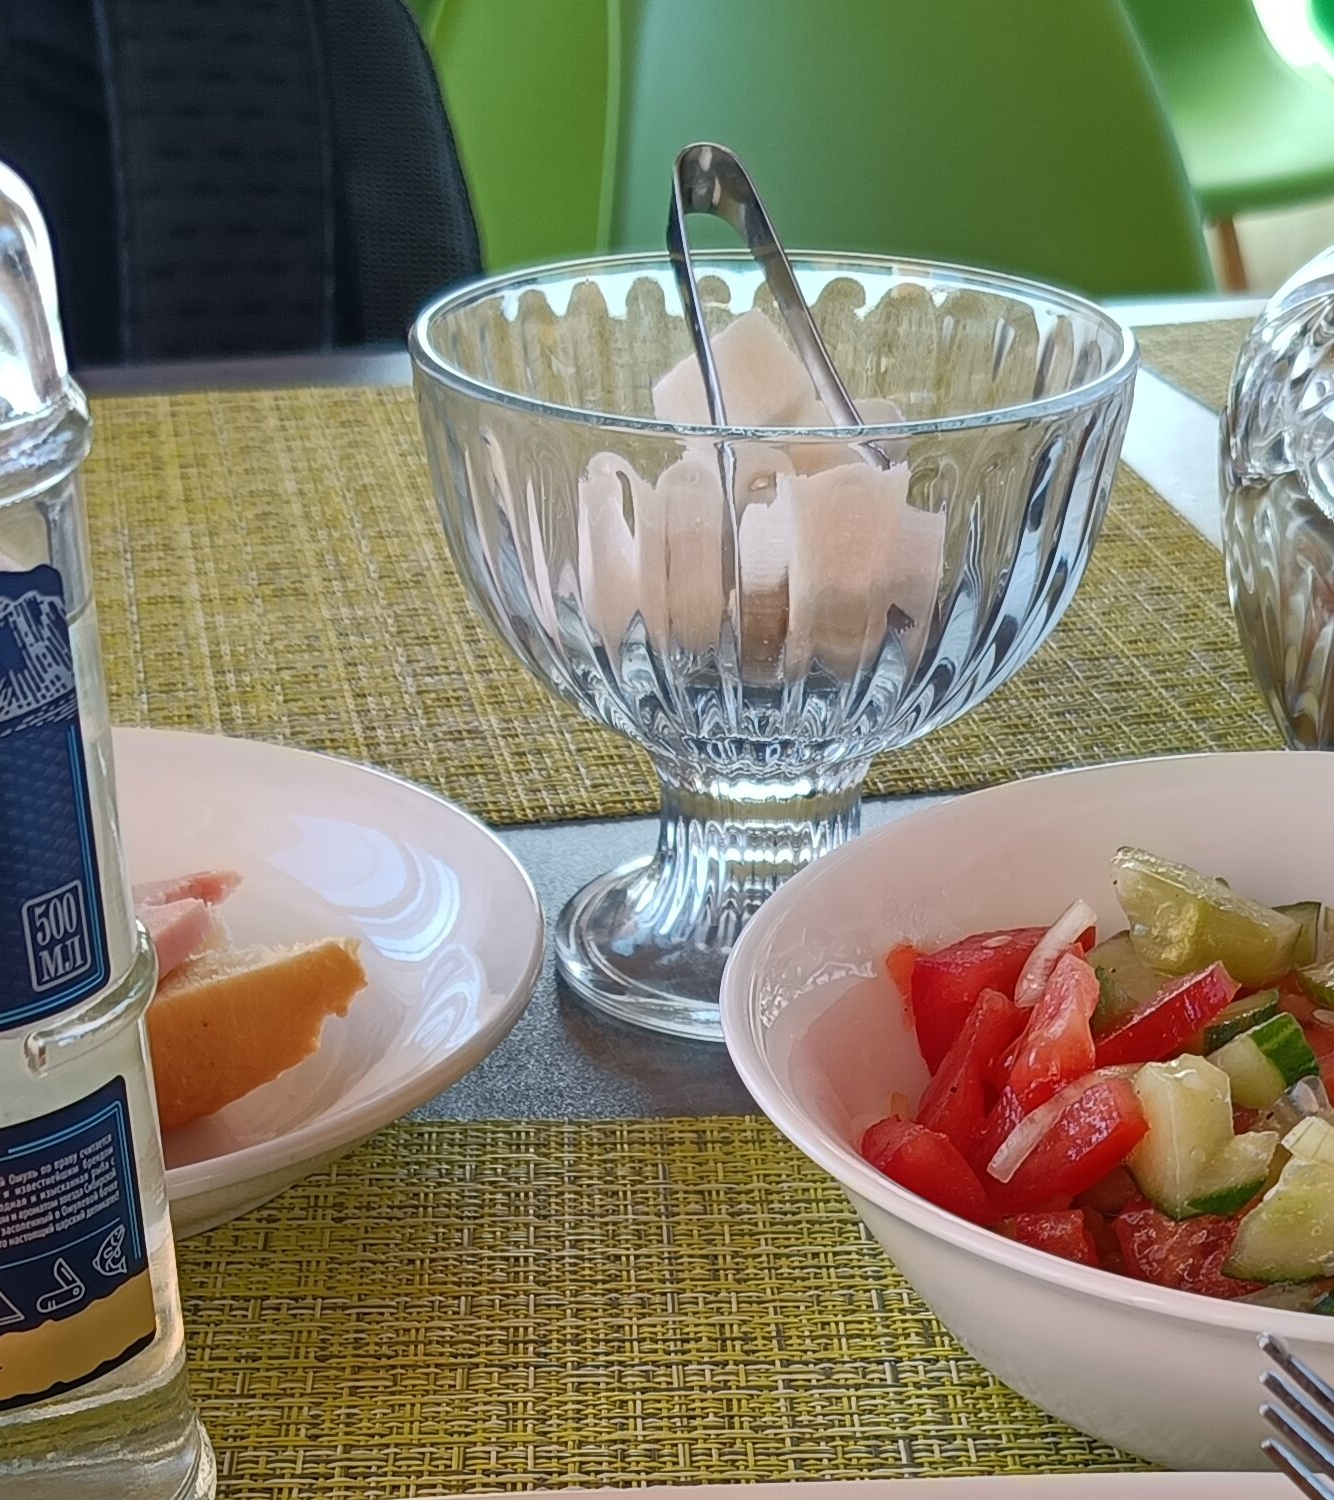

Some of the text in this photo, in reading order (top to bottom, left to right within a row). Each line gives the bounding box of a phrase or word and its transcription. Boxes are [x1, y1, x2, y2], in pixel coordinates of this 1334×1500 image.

[33, 892, 78, 946] 500
[3, 1190, 10, 1198] и
[15, 1165, 79, 1195] известнейшим
[82, 1146, 114, 1171] брендом
[8, 1168, 38, 1186] Омуль
[40, 1165, 52, 1176] по
[54, 1154, 78, 1172] праву
[79, 1133, 113, 1161] считается
[30, 1193, 37, 1202] и
[39, 1174, 89, 1200] изысканная
[90, 1162, 109, 1180] рыба
[110, 1158, 115, 1166] с
[1, 1213, 54, 1235] засоленный
[61, 1197, 98, 1217] Омулевой
[99, 1180, 118, 1198] бочке
[9, 1226, 55, 1249] настоящий
[55, 1210, 85, 1232] царский
[18, 1198, 58, 1220] ароматом
